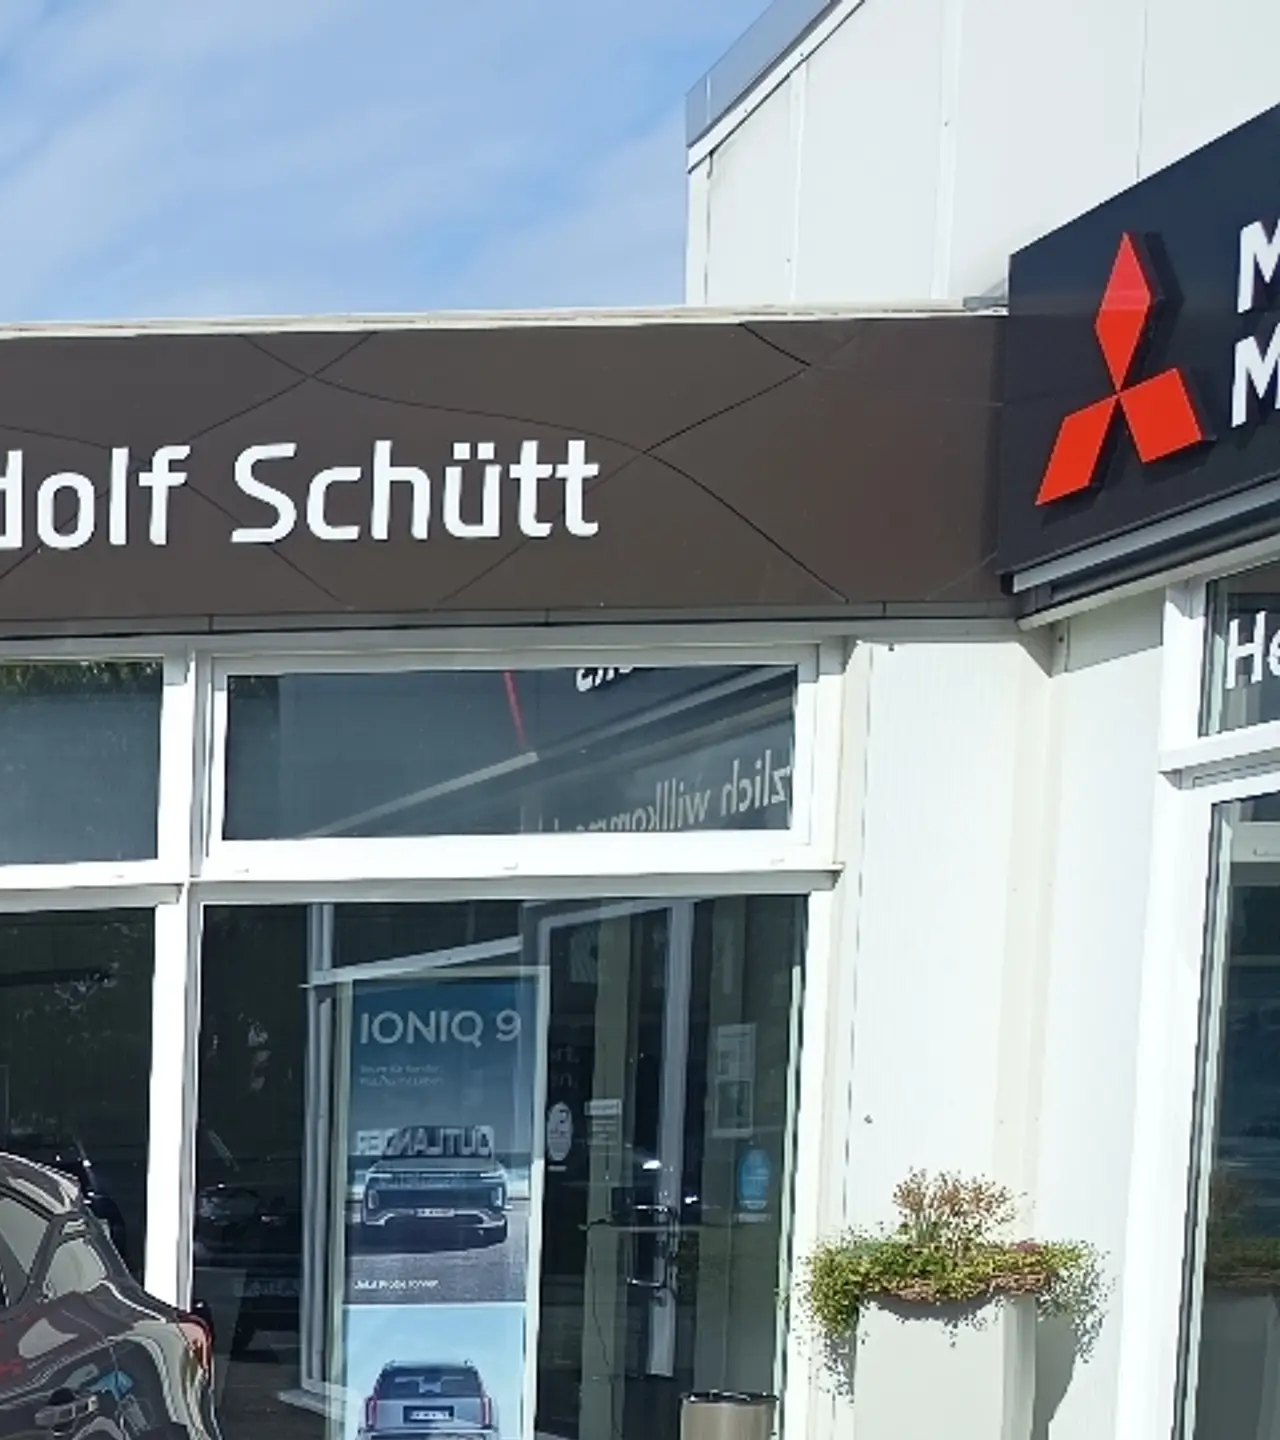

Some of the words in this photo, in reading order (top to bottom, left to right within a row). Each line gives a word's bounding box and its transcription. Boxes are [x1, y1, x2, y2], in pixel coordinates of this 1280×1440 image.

[231, 439, 600, 543] Schütt
[360, 1010, 484, 1048] IONIQ
[496, 1009, 522, 1041] 9
